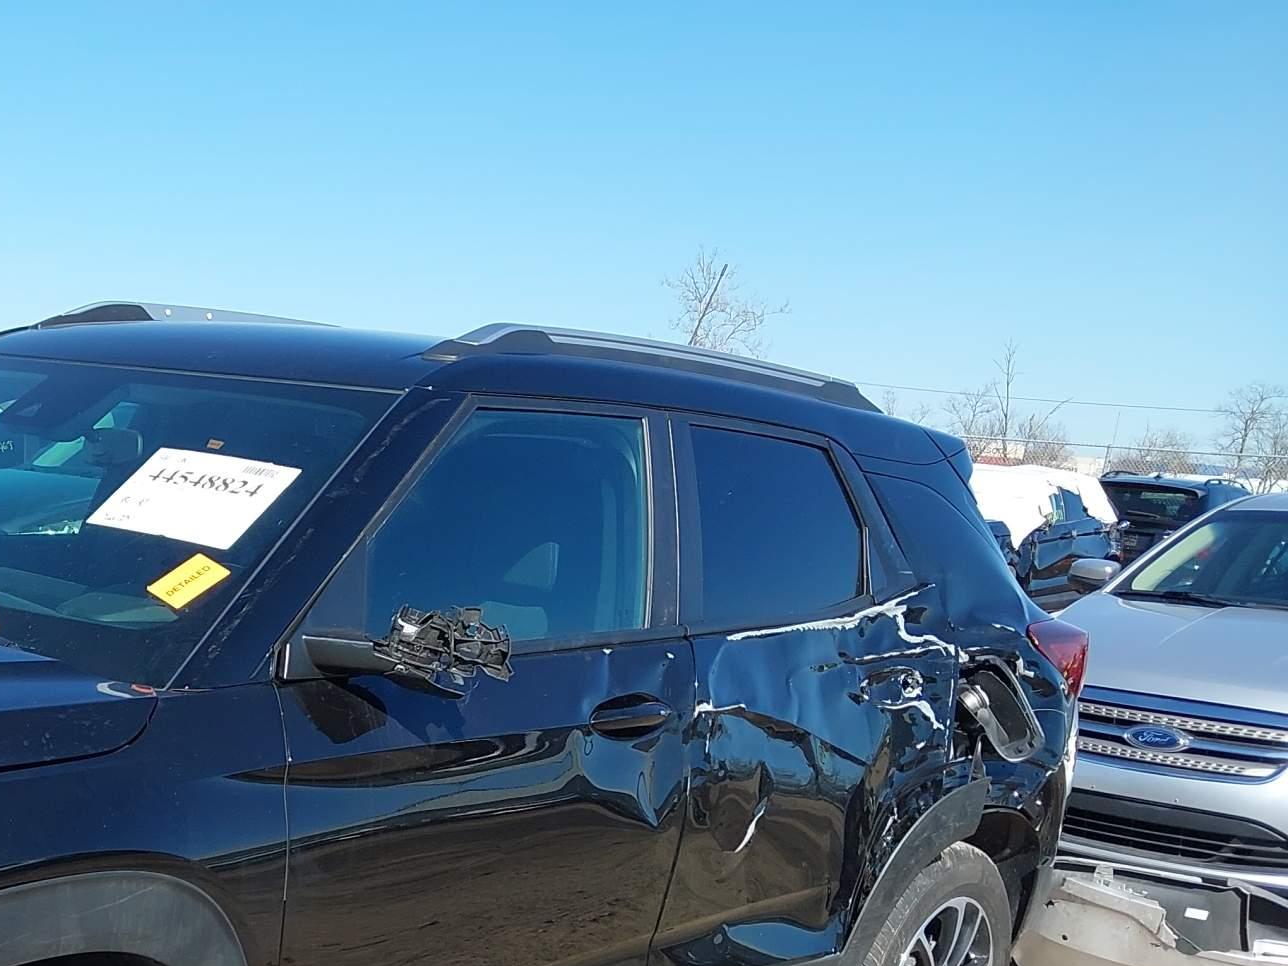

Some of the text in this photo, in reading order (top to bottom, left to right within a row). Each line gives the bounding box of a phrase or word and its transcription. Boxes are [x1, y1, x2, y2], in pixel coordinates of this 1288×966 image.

[149, 468, 265, 498] 44548824
[165, 565, 211, 597] DETAILED
[1138, 730, 1171, 743] Ford
